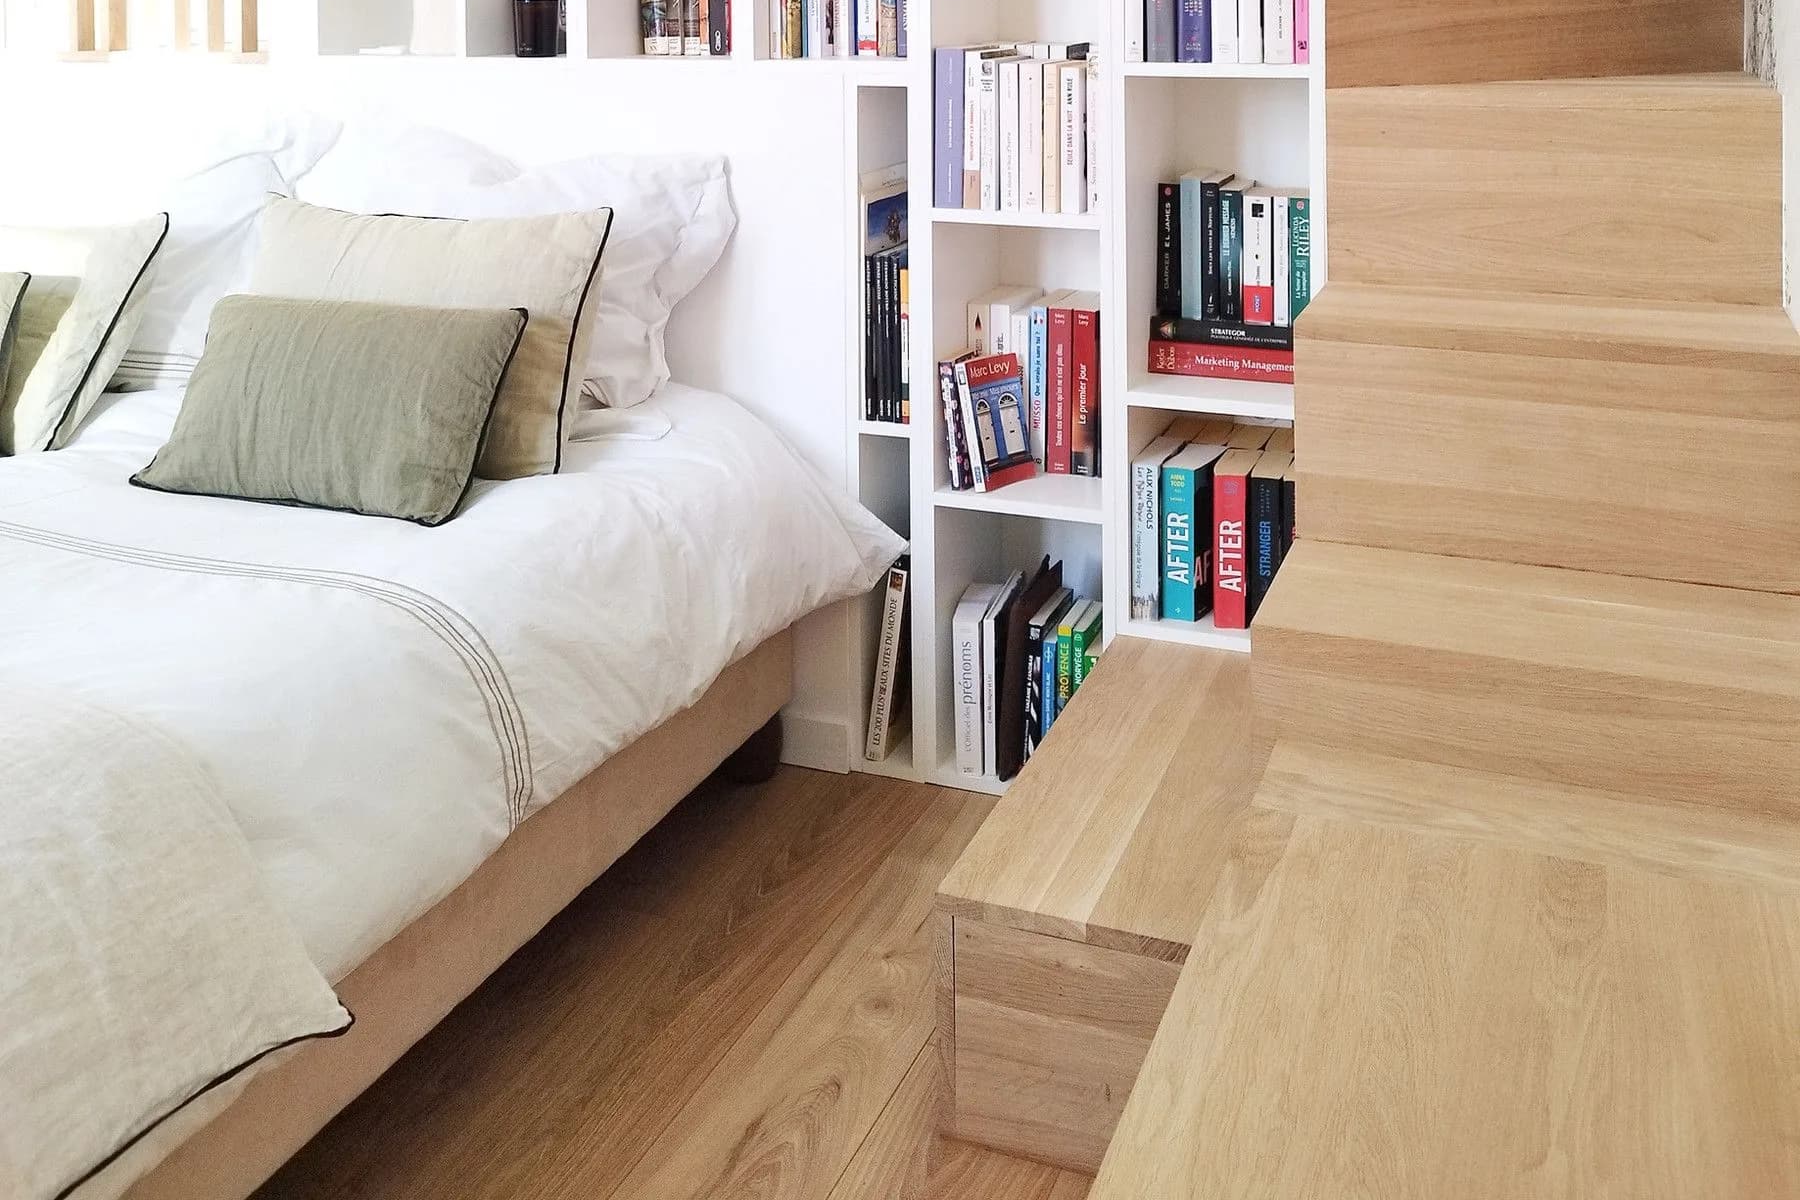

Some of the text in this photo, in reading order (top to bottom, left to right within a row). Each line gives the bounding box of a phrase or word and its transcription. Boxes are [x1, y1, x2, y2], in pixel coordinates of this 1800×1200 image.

[1292, 216, 1300, 247] LUCINDA
[1296, 216, 1309, 257] RILEY
[1210, 328, 1246, 337] STRATEGOR
[969, 361, 1010, 379] Marc Levy
[1056, 357, 1064, 367] pas
[1194, 355, 1294, 373] Marketing Managemen
[1055, 387, 1065, 402] qu'on
[1055, 402, 1063, 420] choses
[1078, 363, 1088, 425] Le premier jour
[1033, 399, 1041, 430] MUSSO
[1146, 490, 1154, 530] NICHOLS
[1166, 512, 1189, 585] AFTER
[1218, 519, 1242, 593] AFTER
[1259, 520, 1271, 577] STRANGER
[872, 598, 897, 746] LES 200 PLUS BEAUX SITES DU MONDE
[958, 641, 976, 705] prénoms
[1059, 643, 1069, 699] PROVENCE
